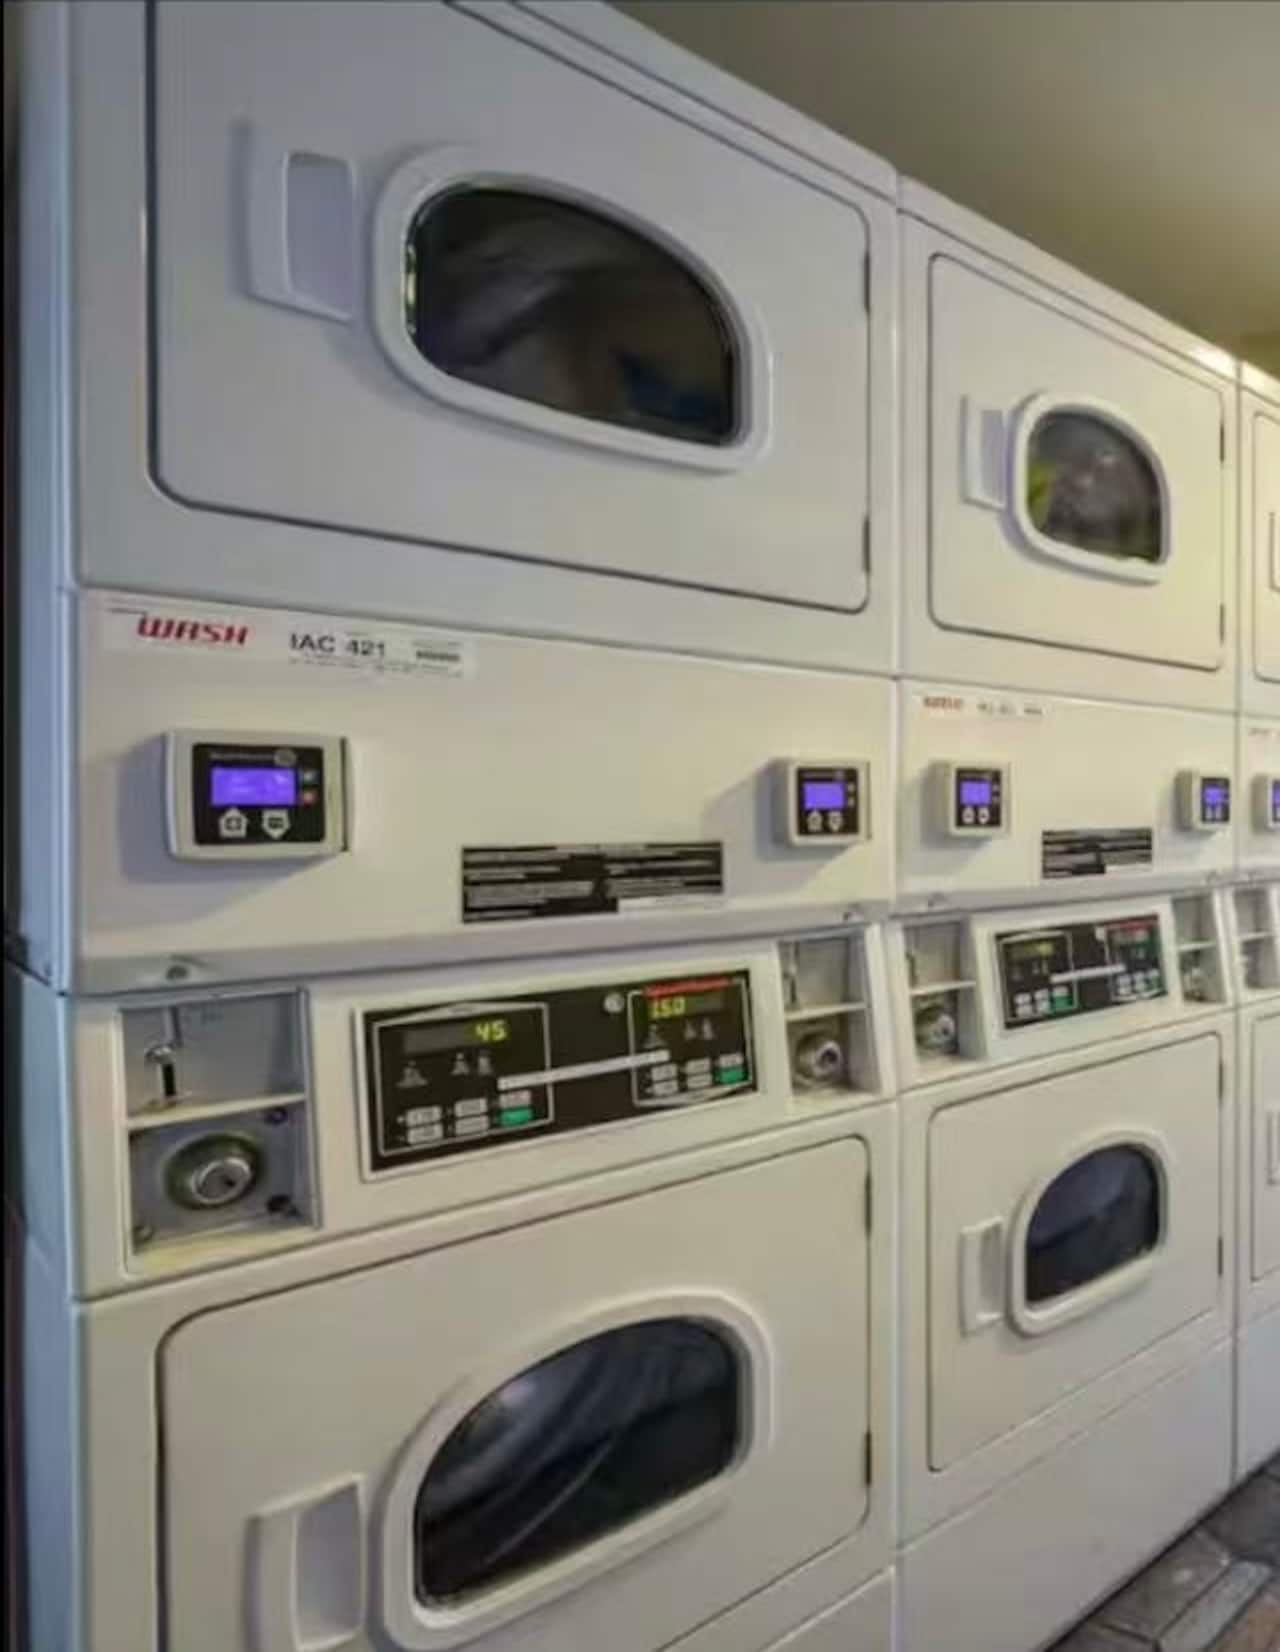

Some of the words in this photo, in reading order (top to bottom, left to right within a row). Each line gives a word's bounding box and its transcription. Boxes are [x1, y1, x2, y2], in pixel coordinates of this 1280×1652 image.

[136, 615, 248, 645] WASH
[289, 632, 335, 654] IAC
[345, 639, 386, 658] 421
[475, 1020, 507, 1041] 45
